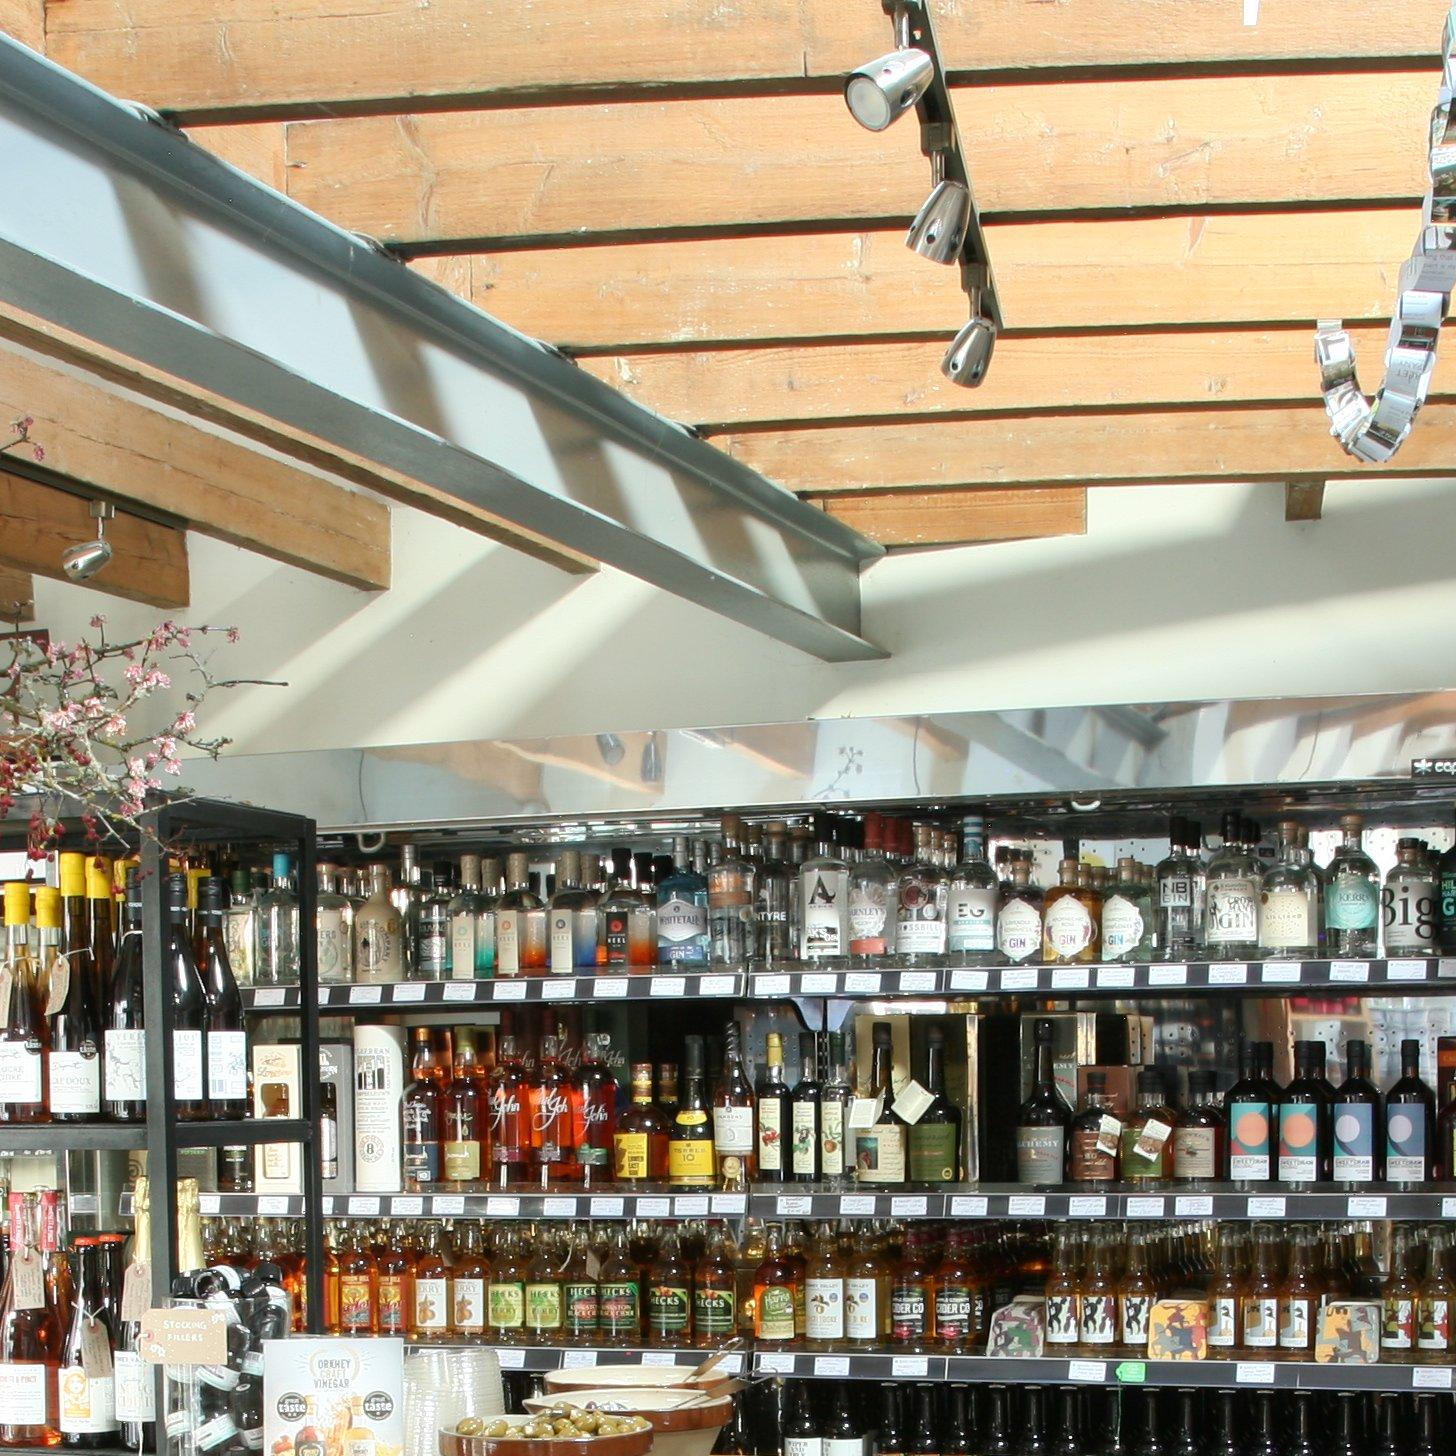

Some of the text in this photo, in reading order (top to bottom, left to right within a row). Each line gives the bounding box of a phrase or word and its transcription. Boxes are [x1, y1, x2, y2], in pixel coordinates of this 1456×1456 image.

[1162, 882, 1187, 893] NB
[1162, 894, 1188, 904] GIN
[1218, 913, 1255, 930] GIN
[1008, 938, 1026, 949] GIN
[1059, 935, 1077, 946] GIN
[1107, 935, 1124, 946] GIN
[163, 1320, 207, 1331] STOCKING
[166, 1333, 204, 1342] FILLERS
[313, 1378, 350, 1389] VINEGAR
[278, 1402, 306, 1412] taste
[364, 1401, 393, 1412] taste
